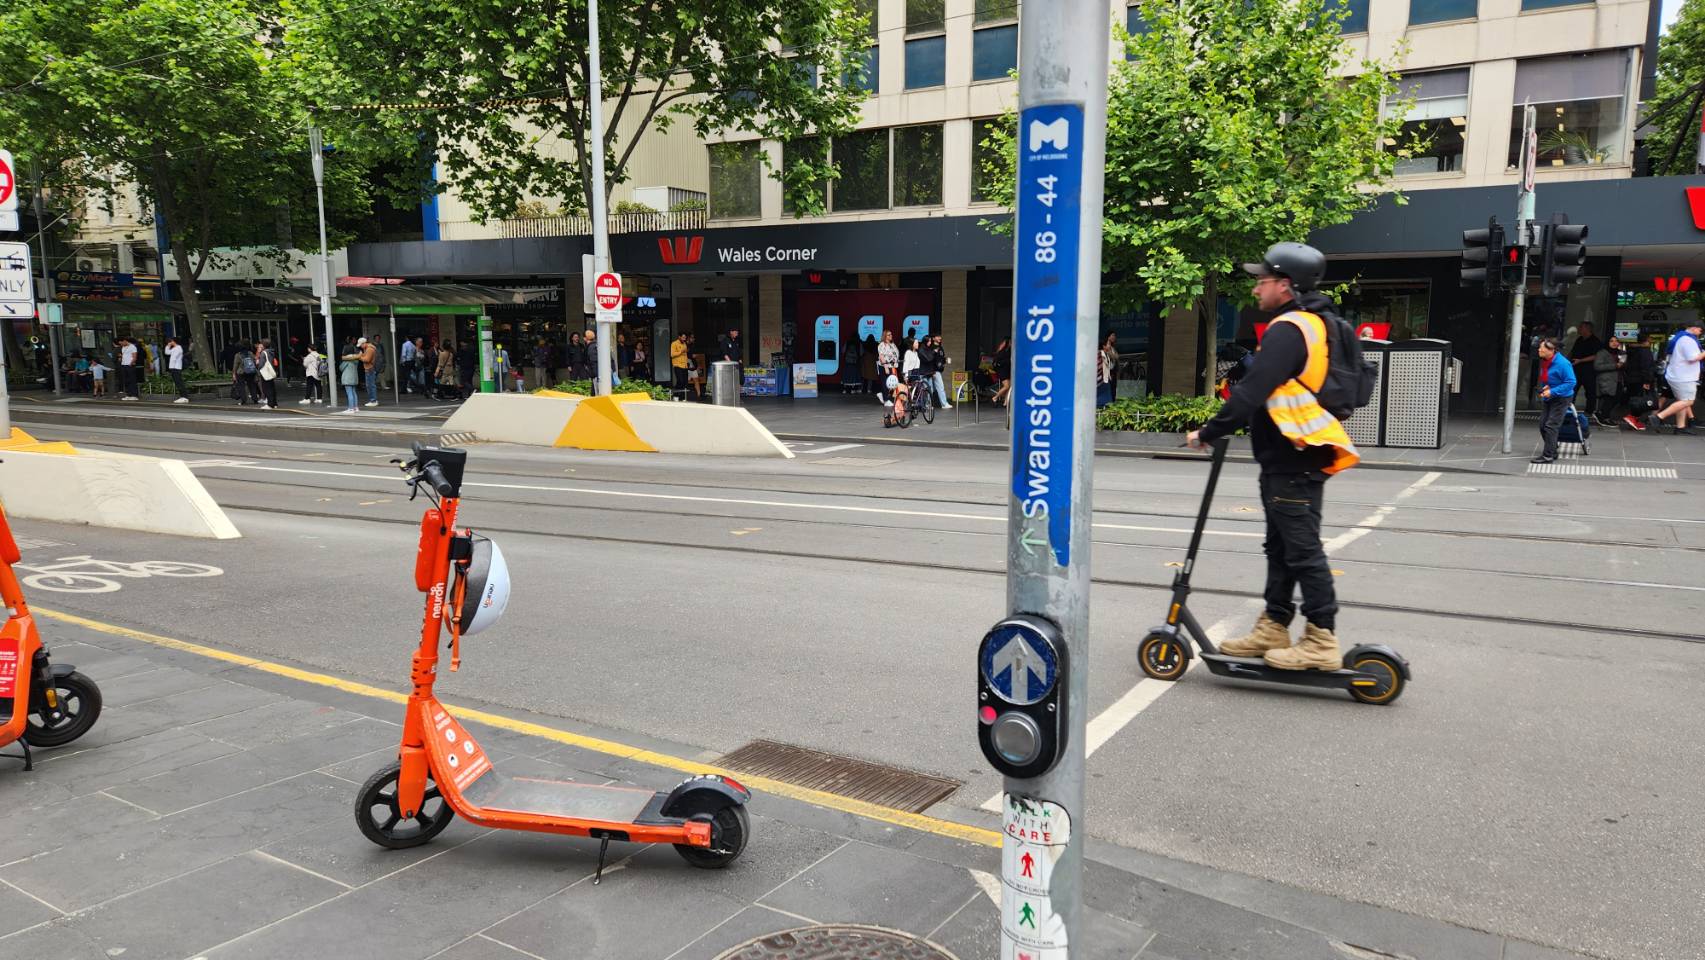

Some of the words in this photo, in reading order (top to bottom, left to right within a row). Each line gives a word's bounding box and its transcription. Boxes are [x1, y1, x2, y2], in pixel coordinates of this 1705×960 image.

[1037, 174, 1059, 207] 44
[717, 247, 761, 263] Wales
[765, 246, 817, 262] Corner
[1035, 230, 1057, 263] 86
[603, 278, 613, 286] NO
[600, 296, 617, 304] ENTRY
[1026, 304, 1055, 343] St
[1021, 354, 1054, 520] Swanston
[431, 582, 445, 619] neuron
[483, 583, 495, 609] neuron
[1009, 823, 1052, 842] CARE
[1013, 811, 1048, 830] WITH
